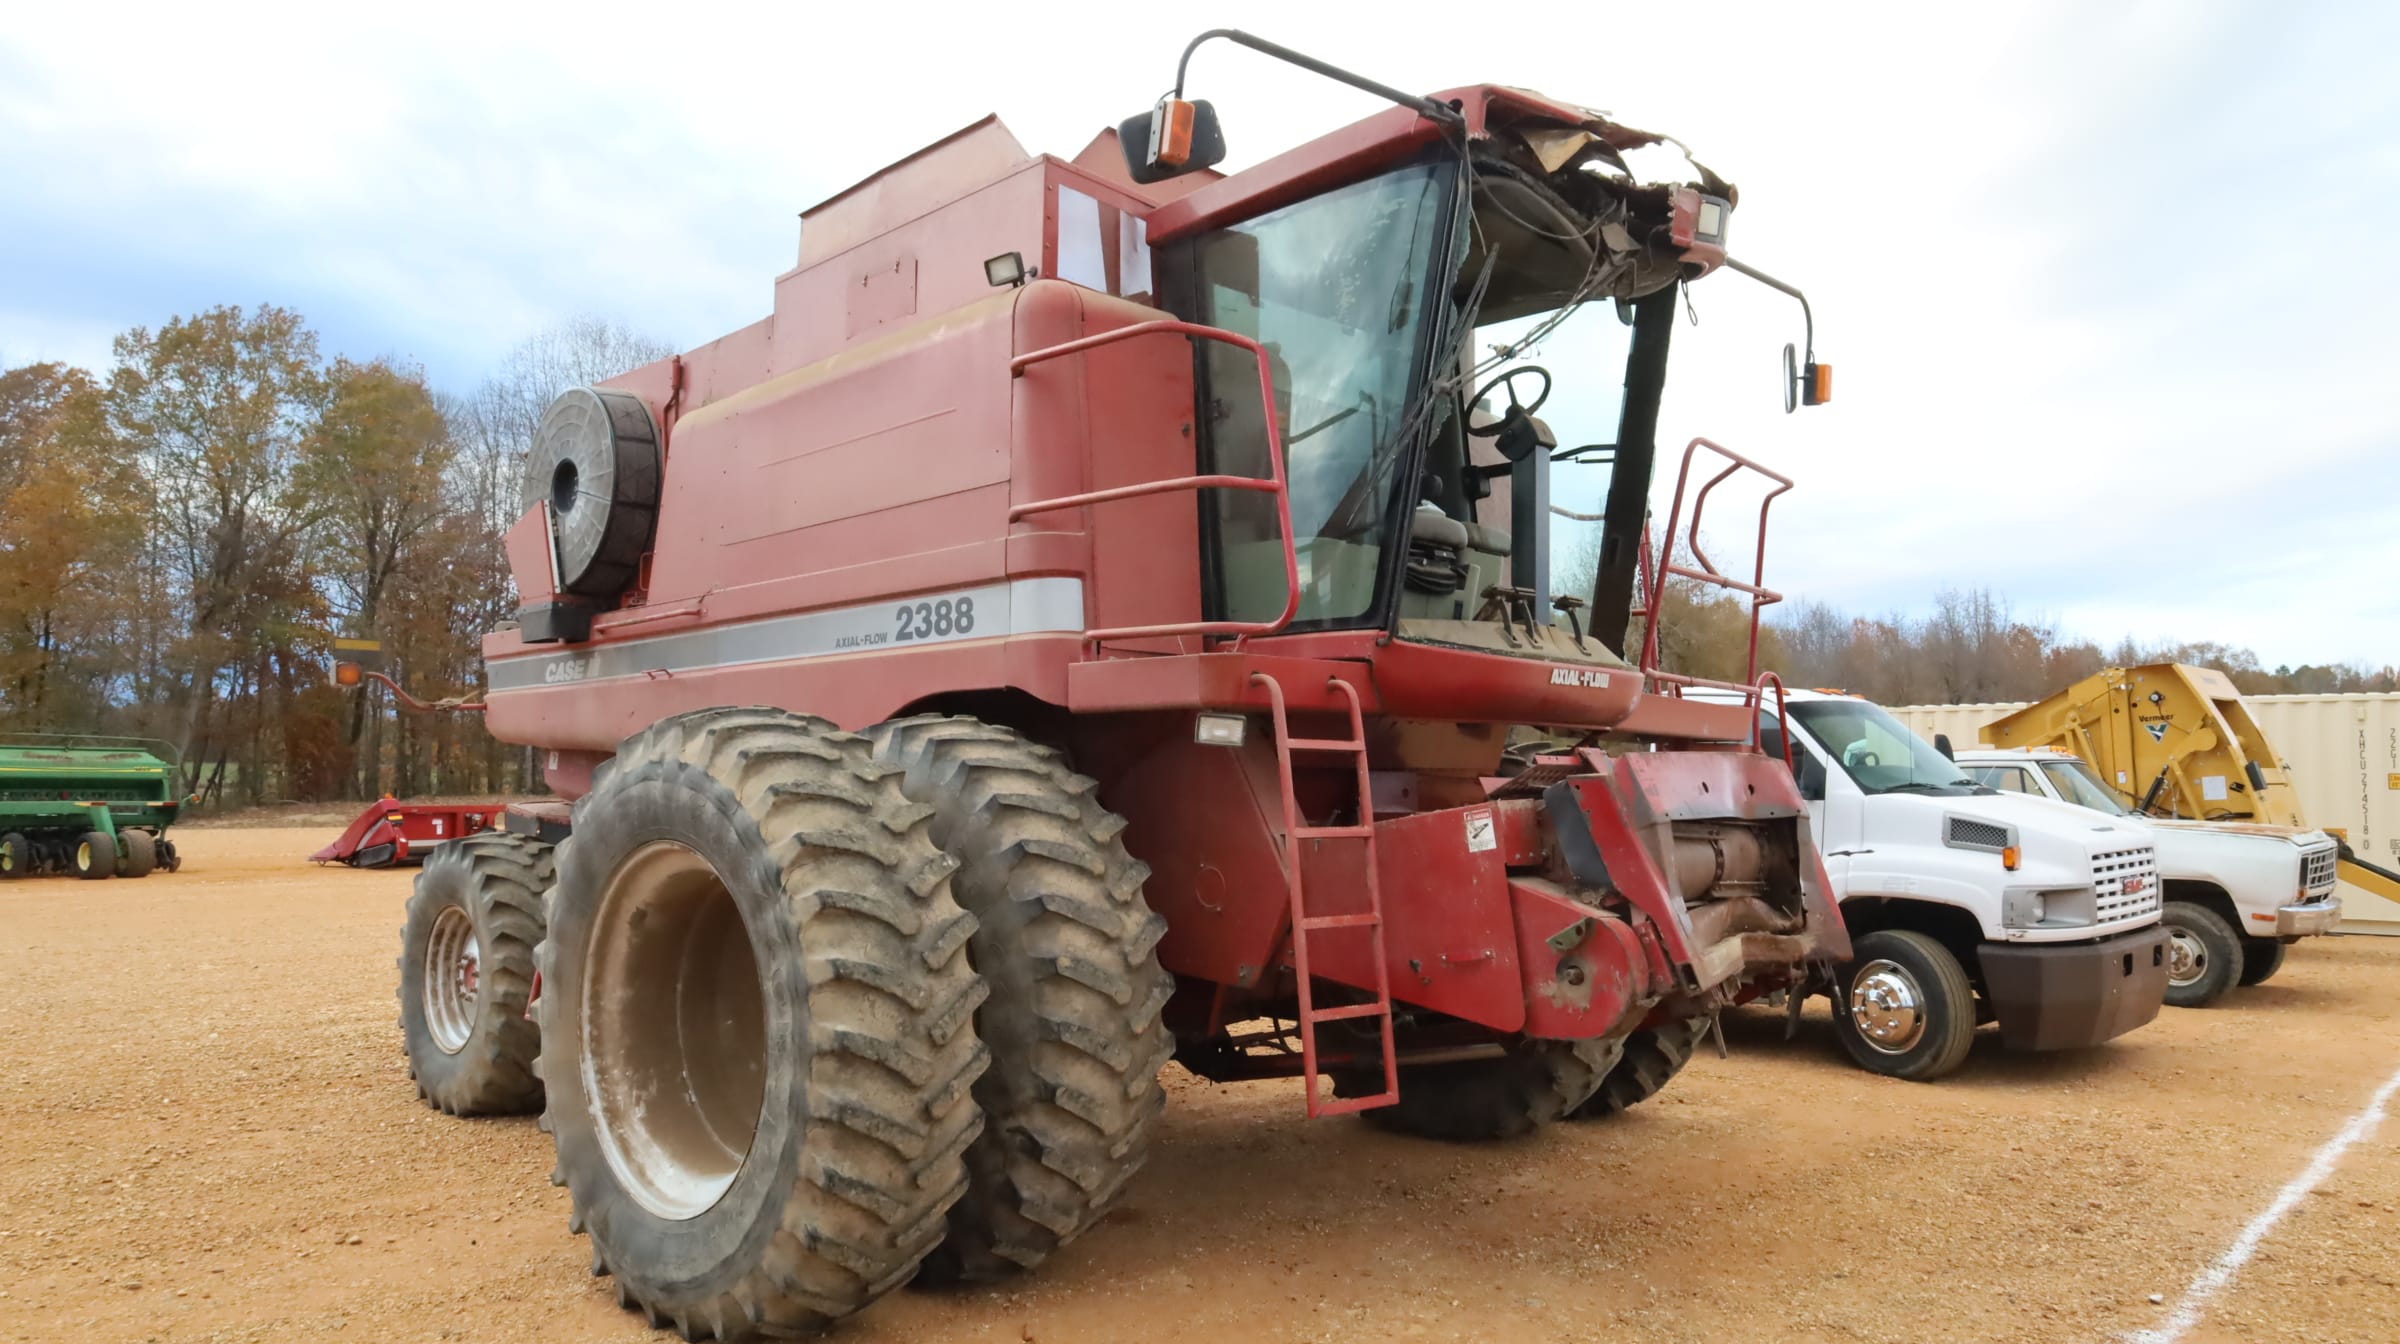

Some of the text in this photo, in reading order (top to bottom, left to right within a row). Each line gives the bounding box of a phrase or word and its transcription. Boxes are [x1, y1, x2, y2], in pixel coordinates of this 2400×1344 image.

[835, 596, 975, 648] AXIAL-FLOW 2388
[545, 659, 586, 682] CASE
[1550, 668, 1610, 689] AXIAL-FLOW
[2139, 714, 2174, 722] Vermeer
